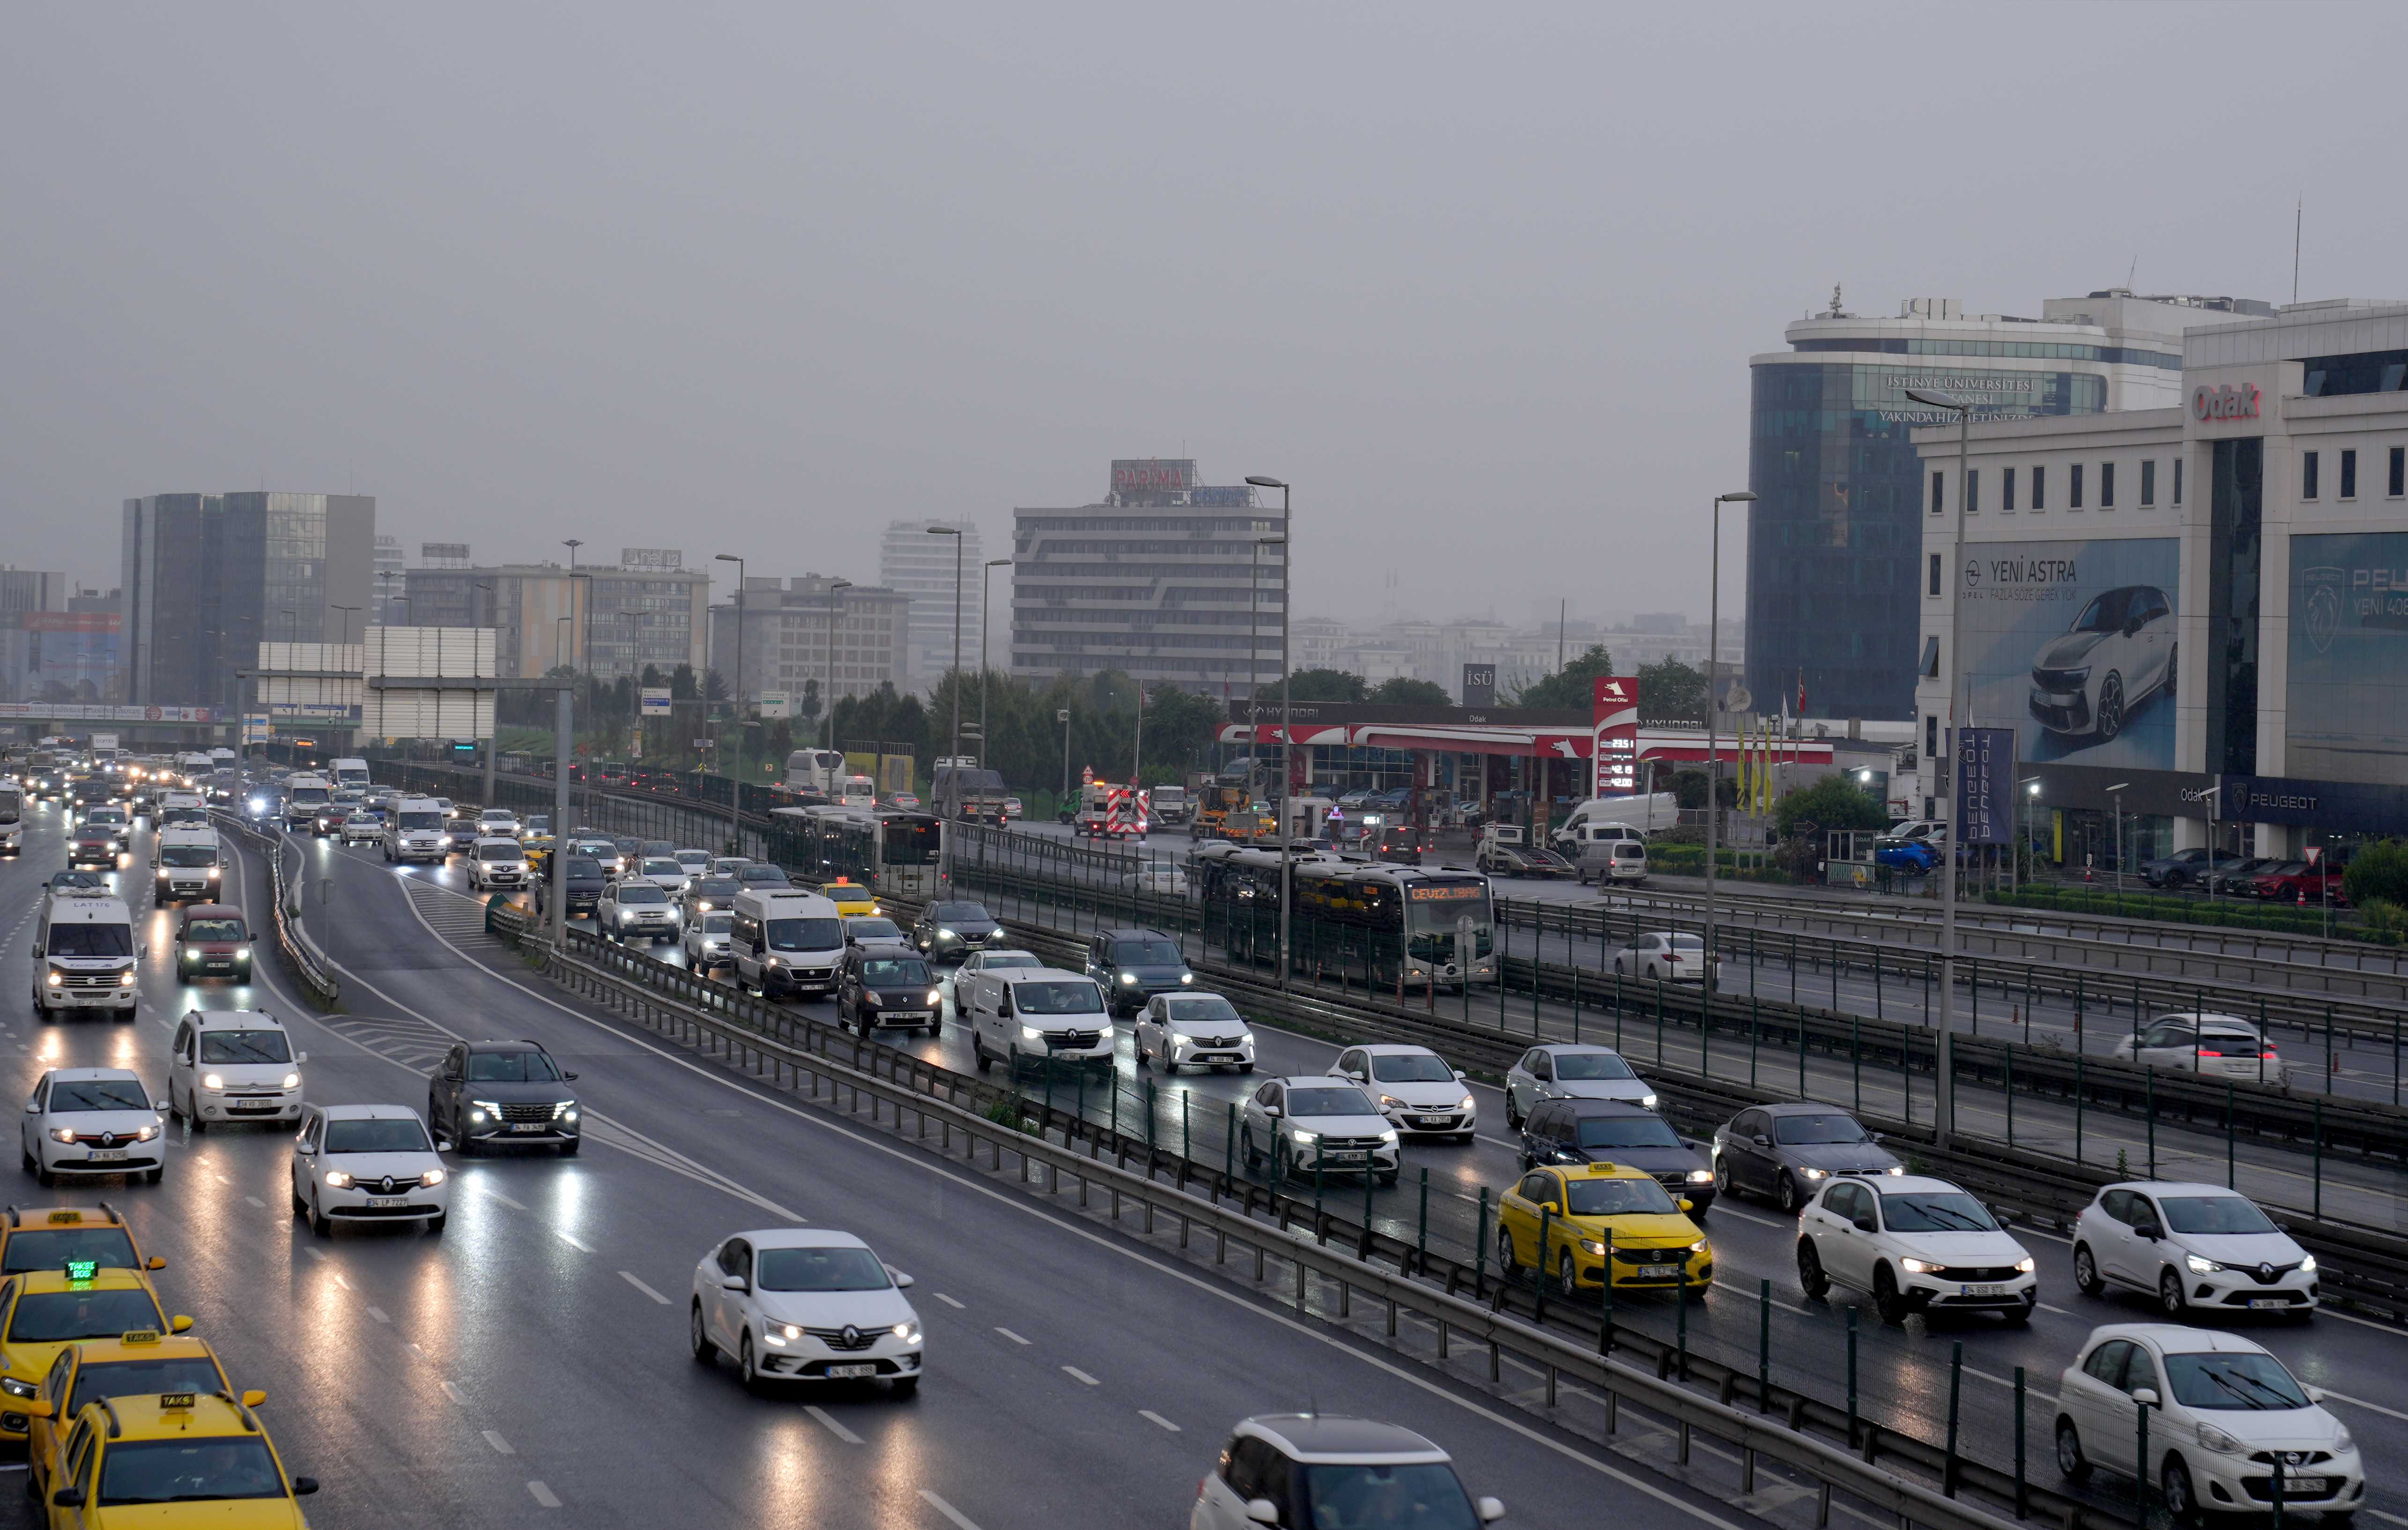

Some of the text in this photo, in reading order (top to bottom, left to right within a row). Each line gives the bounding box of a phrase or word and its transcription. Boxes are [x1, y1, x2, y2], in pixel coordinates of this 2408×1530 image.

[1887, 375, 2035, 391] İSTİNYE ÜNİVERSİTESİ
[2192, 383, 2260, 421] Odak
[1879, 411, 1933, 422] YAKINDA
[1991, 555, 2076, 582] YENİ ASTRA
[1991, 589, 2013, 601] FAZLA
[2036, 588, 2059, 601] GEREK
[2060, 588, 2076, 601] YOK
[2353, 595, 2383, 616] YENİ
[1467, 671, 1493, 685] İSÜ
[2181, 787, 2203, 802] Odak
[2251, 793, 2317, 810] PEUGEOT
